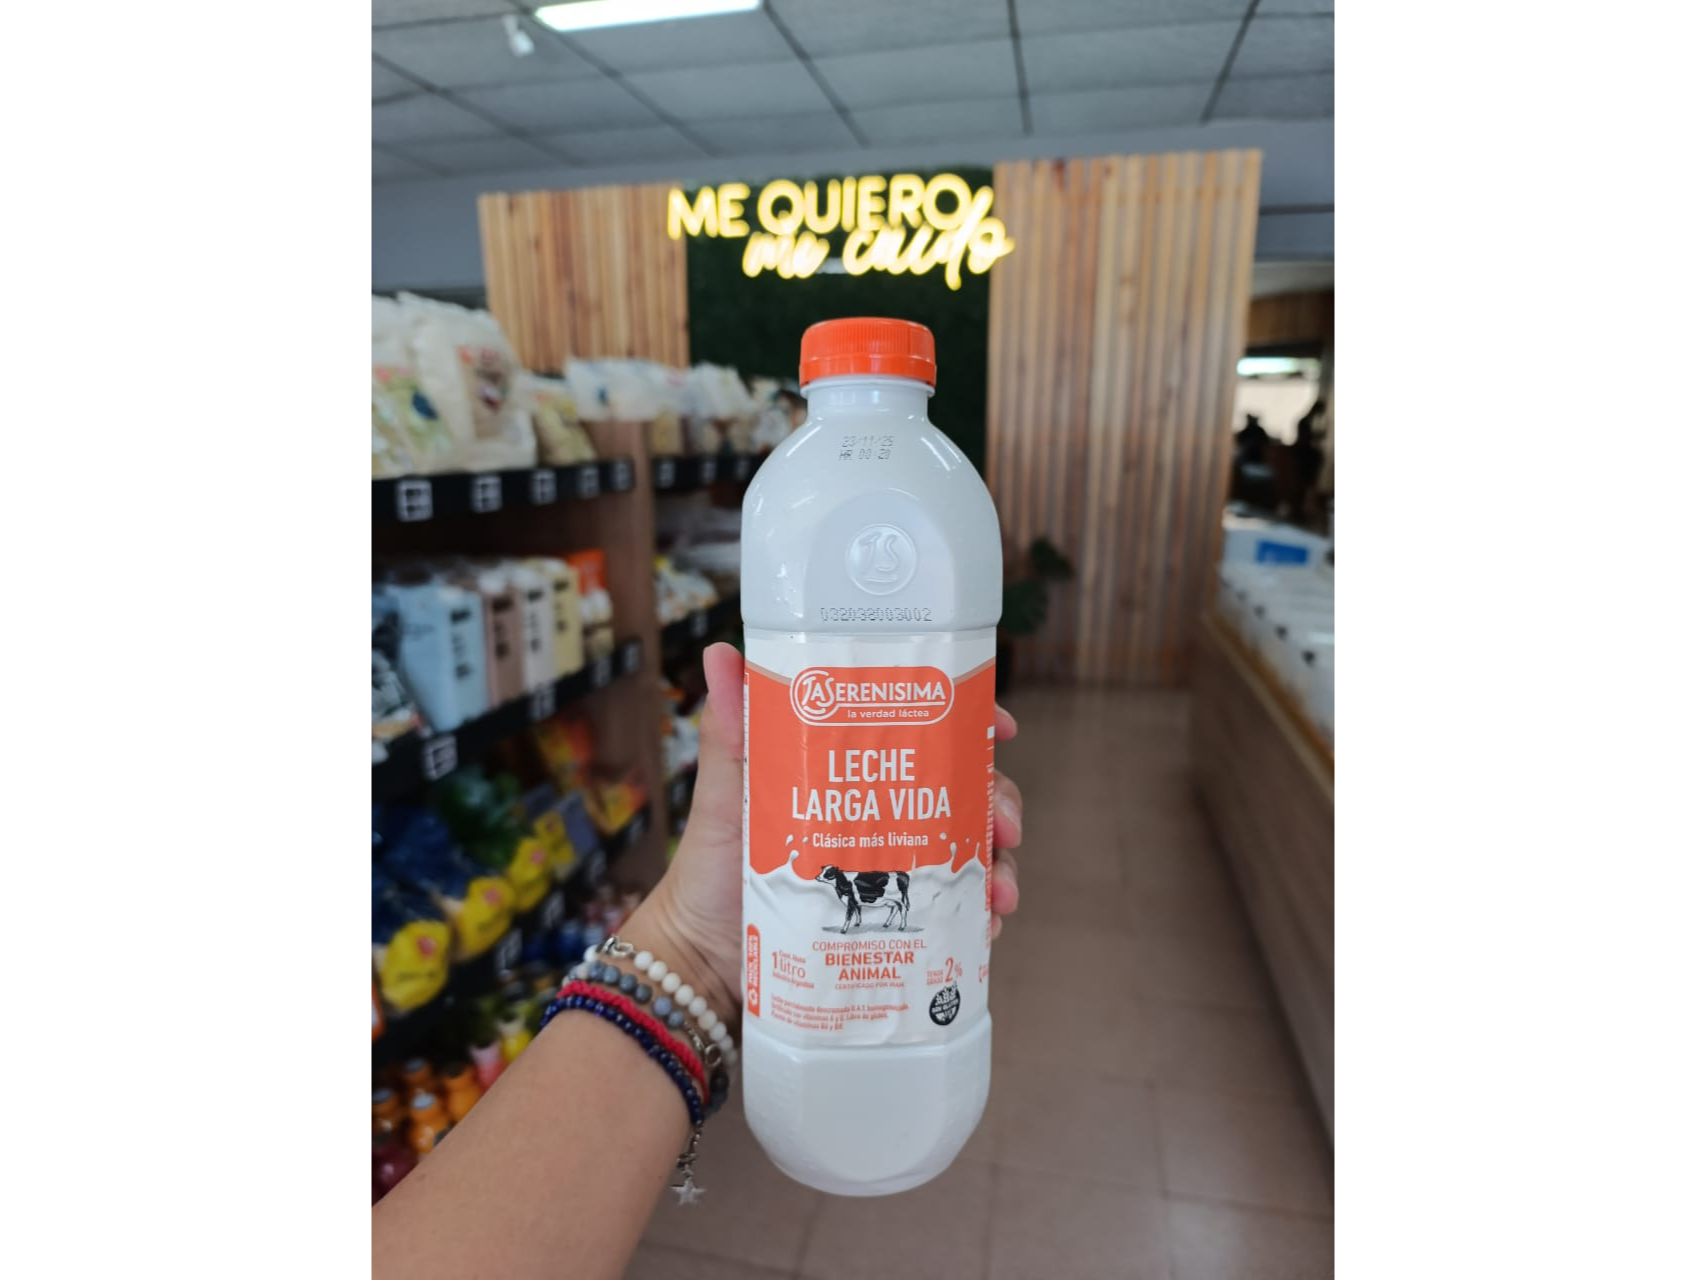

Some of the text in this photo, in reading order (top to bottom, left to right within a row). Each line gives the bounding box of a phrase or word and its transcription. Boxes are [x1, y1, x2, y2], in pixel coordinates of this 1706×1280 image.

[667, 173, 972, 240] ME QUIERO
[847, 709, 929, 719] la verdad láctea
[828, 749, 916, 783] LECHE
[792, 786, 951, 822] LARGA VIDA
[812, 832, 928, 849] Clásica más liviana
[812, 939, 927, 952] COMPROMISO CON EL
[825, 951, 915, 967] BIENESTAR
[838, 966, 901, 981] ANIMAL
